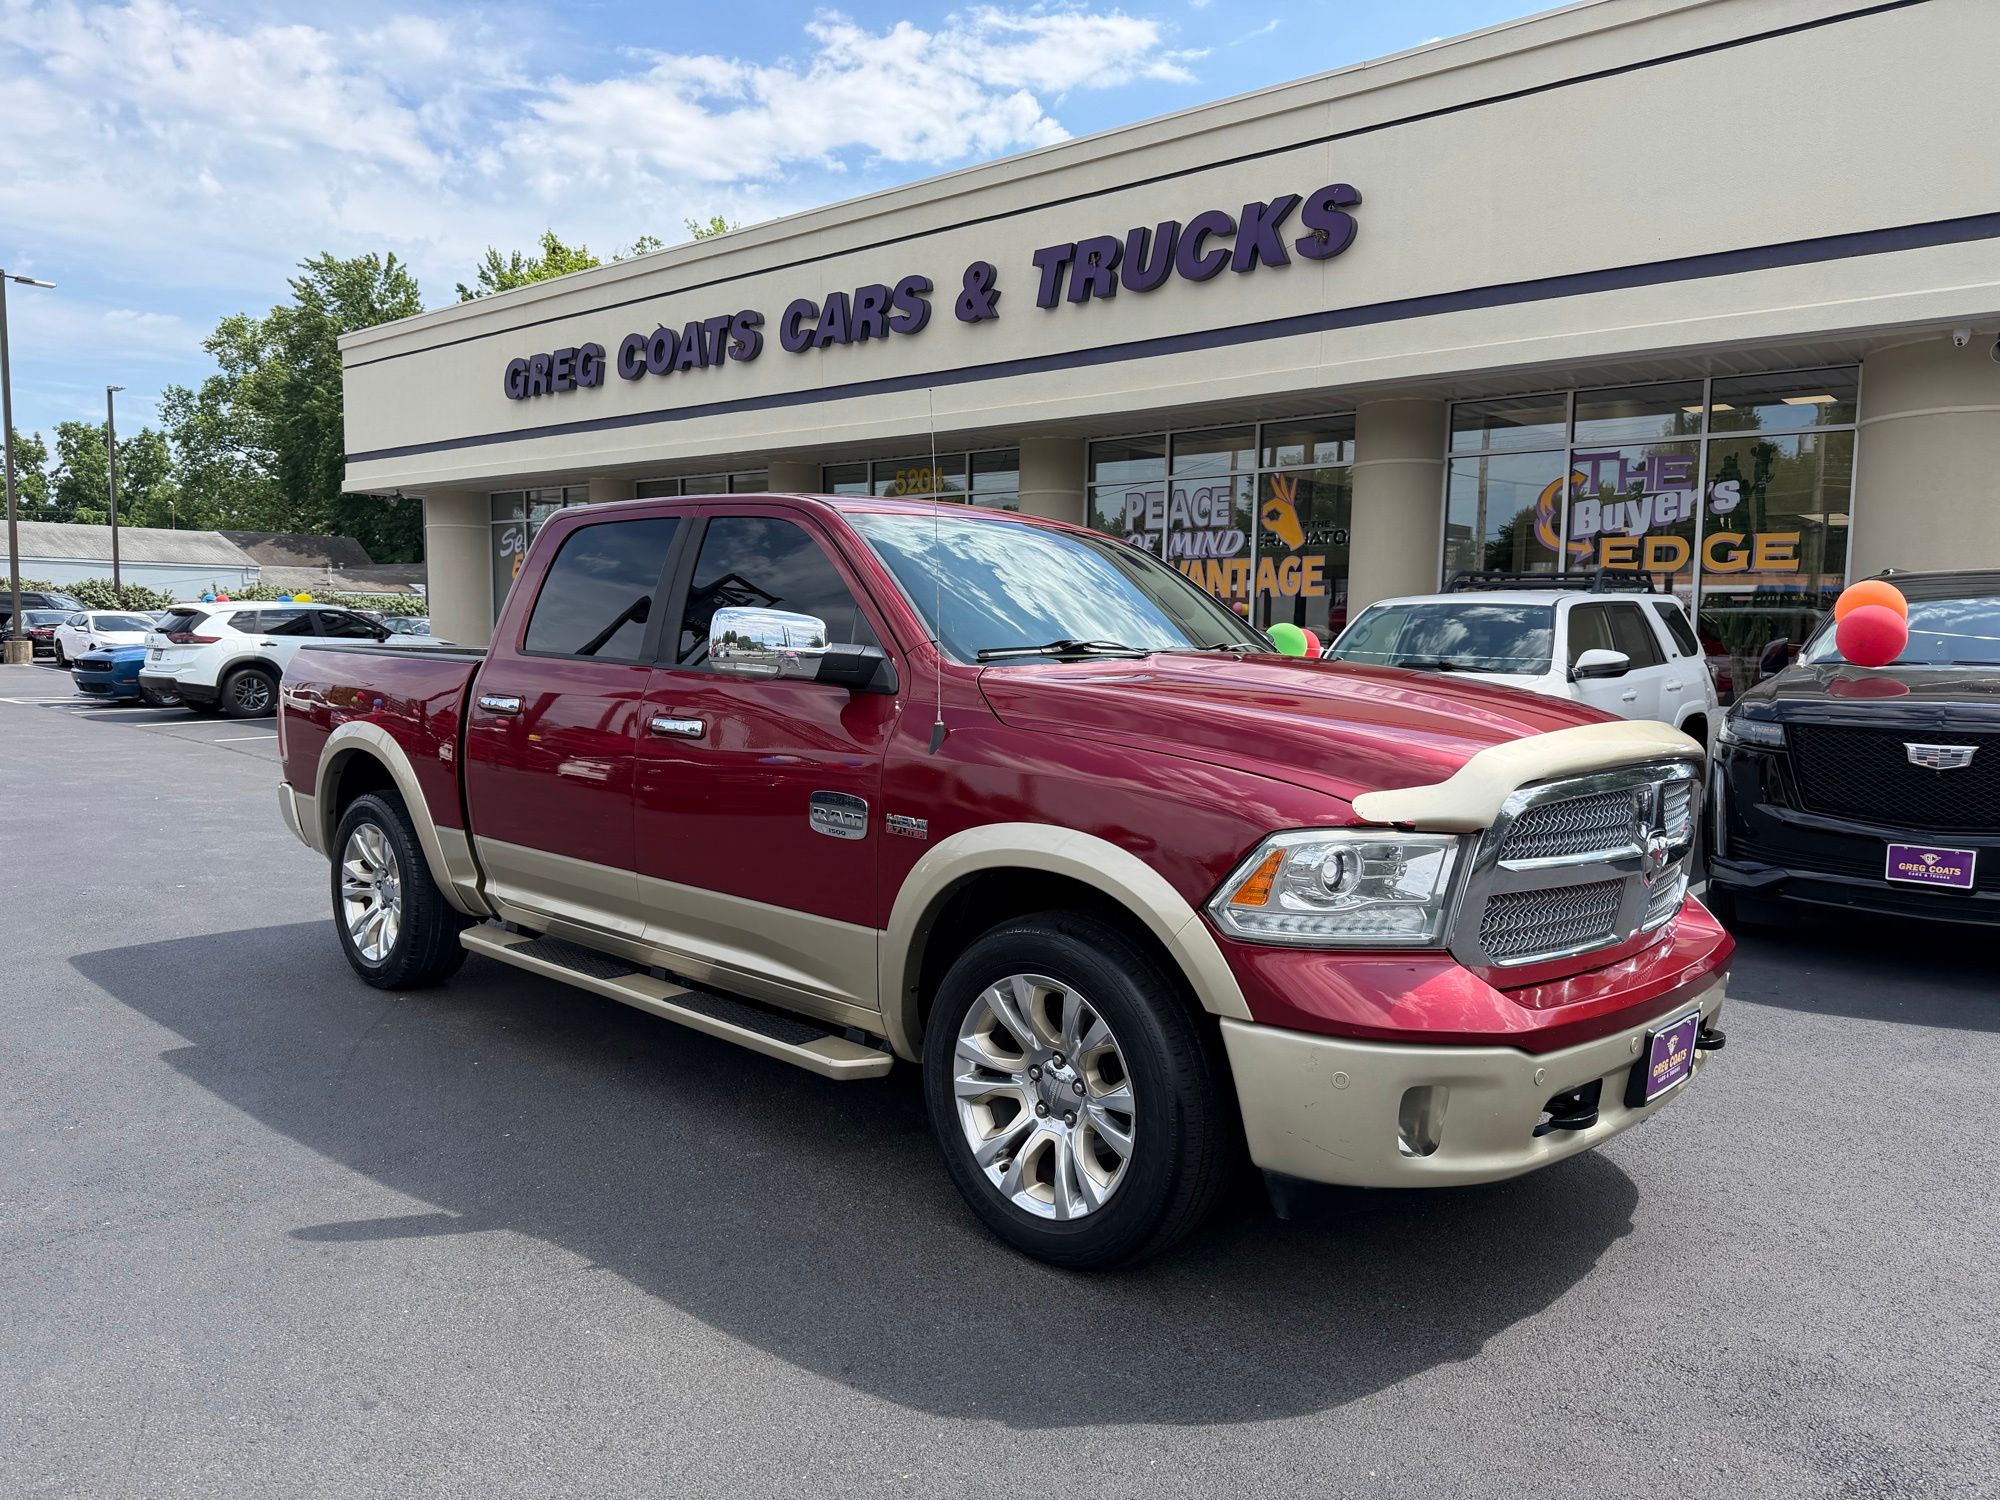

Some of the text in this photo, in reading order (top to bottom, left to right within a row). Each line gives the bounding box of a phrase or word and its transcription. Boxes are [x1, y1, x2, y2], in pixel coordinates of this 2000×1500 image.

[504, 183, 1362, 400] GREG COATS CARS & TRUCKS
[1572, 450, 1696, 496] THE
[1125, 486, 1231, 530] PEACE
[1571, 480, 1741, 539] Buyer's
[1128, 529, 1246, 559] OF MIND
[1599, 531, 1800, 573] EDGE
[813, 806, 864, 828] RAM
[828, 827, 847, 836] 1500
[1898, 862, 1962, 876] GREG COATS
[1652, 1048, 1688, 1077] GREG COATS
